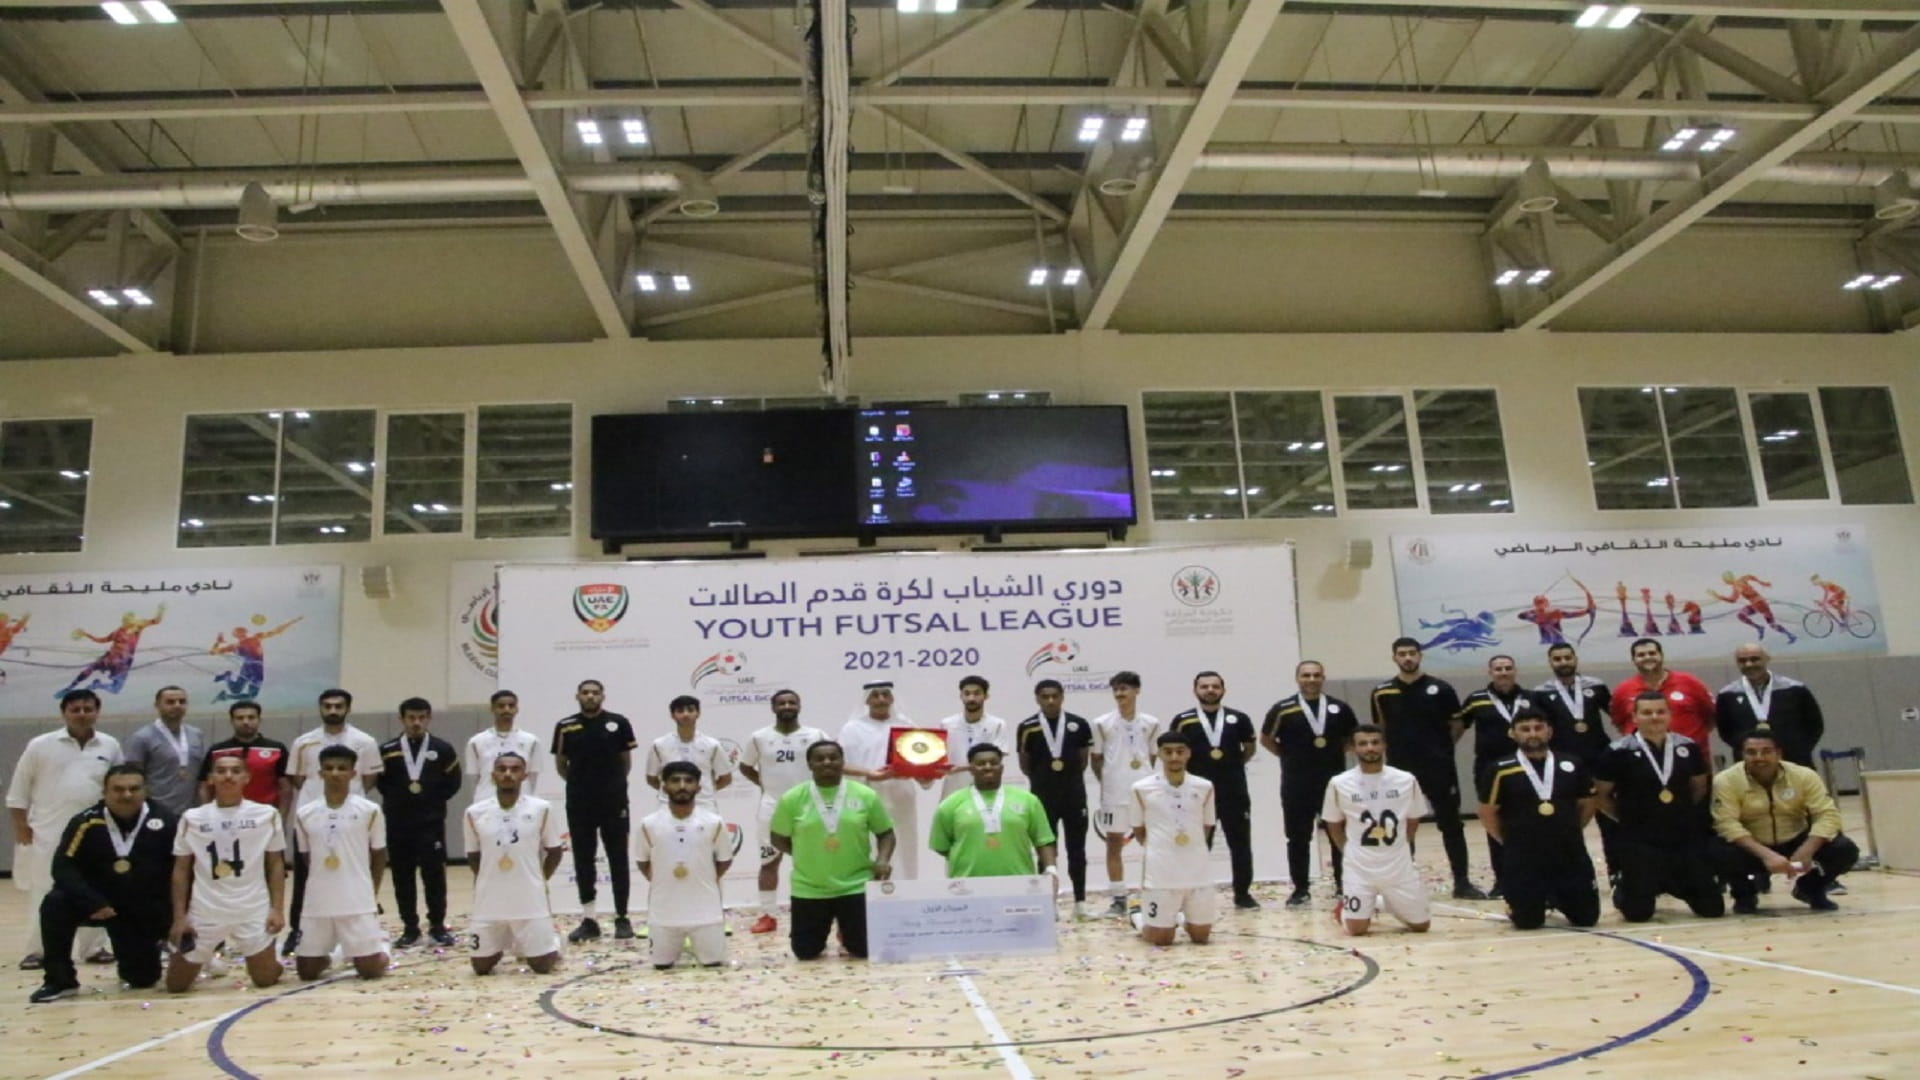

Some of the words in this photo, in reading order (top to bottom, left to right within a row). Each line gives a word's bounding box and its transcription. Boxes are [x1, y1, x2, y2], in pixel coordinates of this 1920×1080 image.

[1493, 542, 1583, 557] الرياضي
[1586, 539, 1668, 555] الثقافي
[100, 580, 181, 594] مليحة
[184, 580, 233, 596] نادي
[587, 595, 615, 604] UAE
[689, 581, 796, 607] الصالات
[806, 581, 867, 613] قدم
[876, 577, 934, 606] لكرة
[943, 574, 1043, 604] الشباب
[1053, 579, 1123, 606] دوري
[694, 616, 823, 640] YOUTH
[835, 612, 970, 636] FUTSAL
[980, 606, 1123, 632] LEAGUE
[844, 647, 980, 671] 2021-2020
[775, 749, 796, 763] 24
[1359, 808, 1399, 847] 20
[206, 838, 245, 880] 14
[1148, 901, 1158, 918] 3
